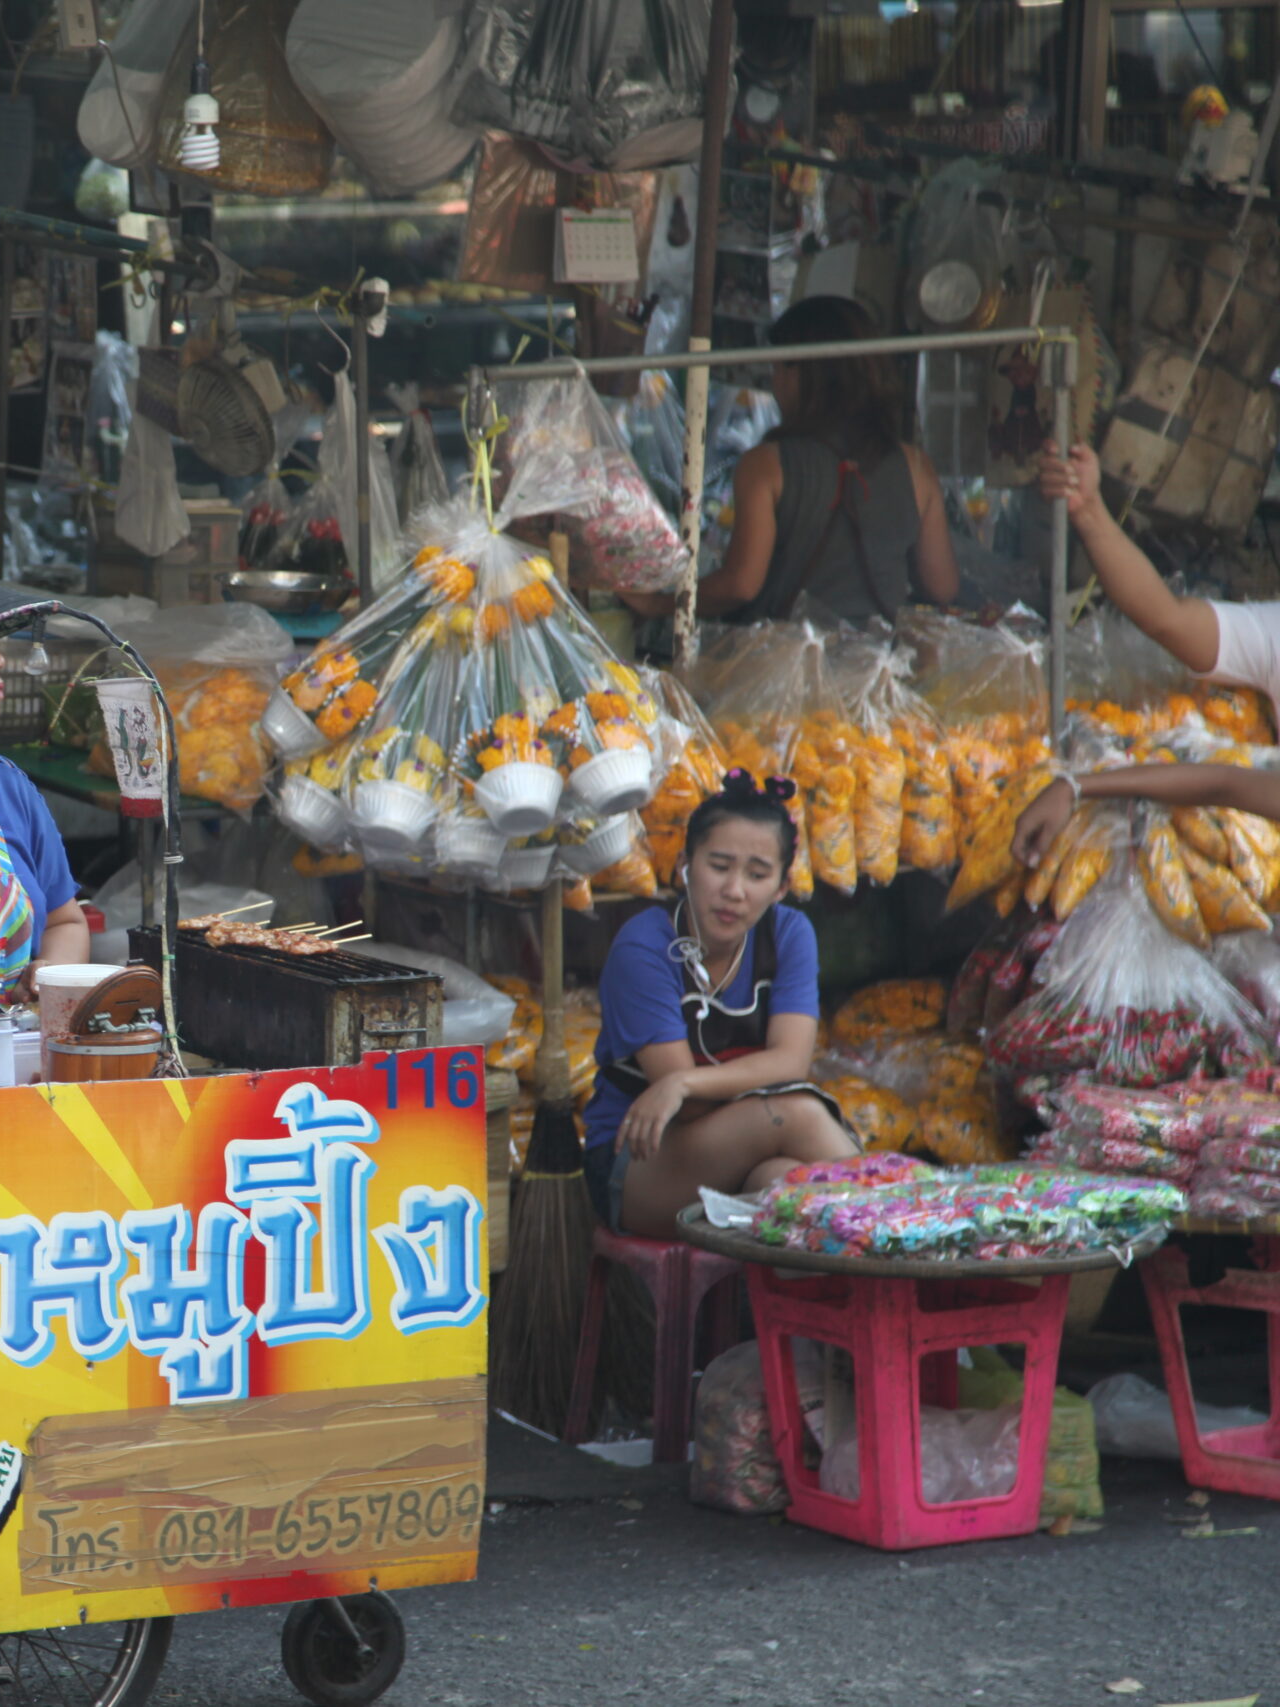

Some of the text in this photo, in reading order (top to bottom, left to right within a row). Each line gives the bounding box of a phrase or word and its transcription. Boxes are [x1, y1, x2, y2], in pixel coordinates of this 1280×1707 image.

[374, 1052, 479, 1109] 116
[37, 1482, 482, 1576] โทร. 081-6557809
